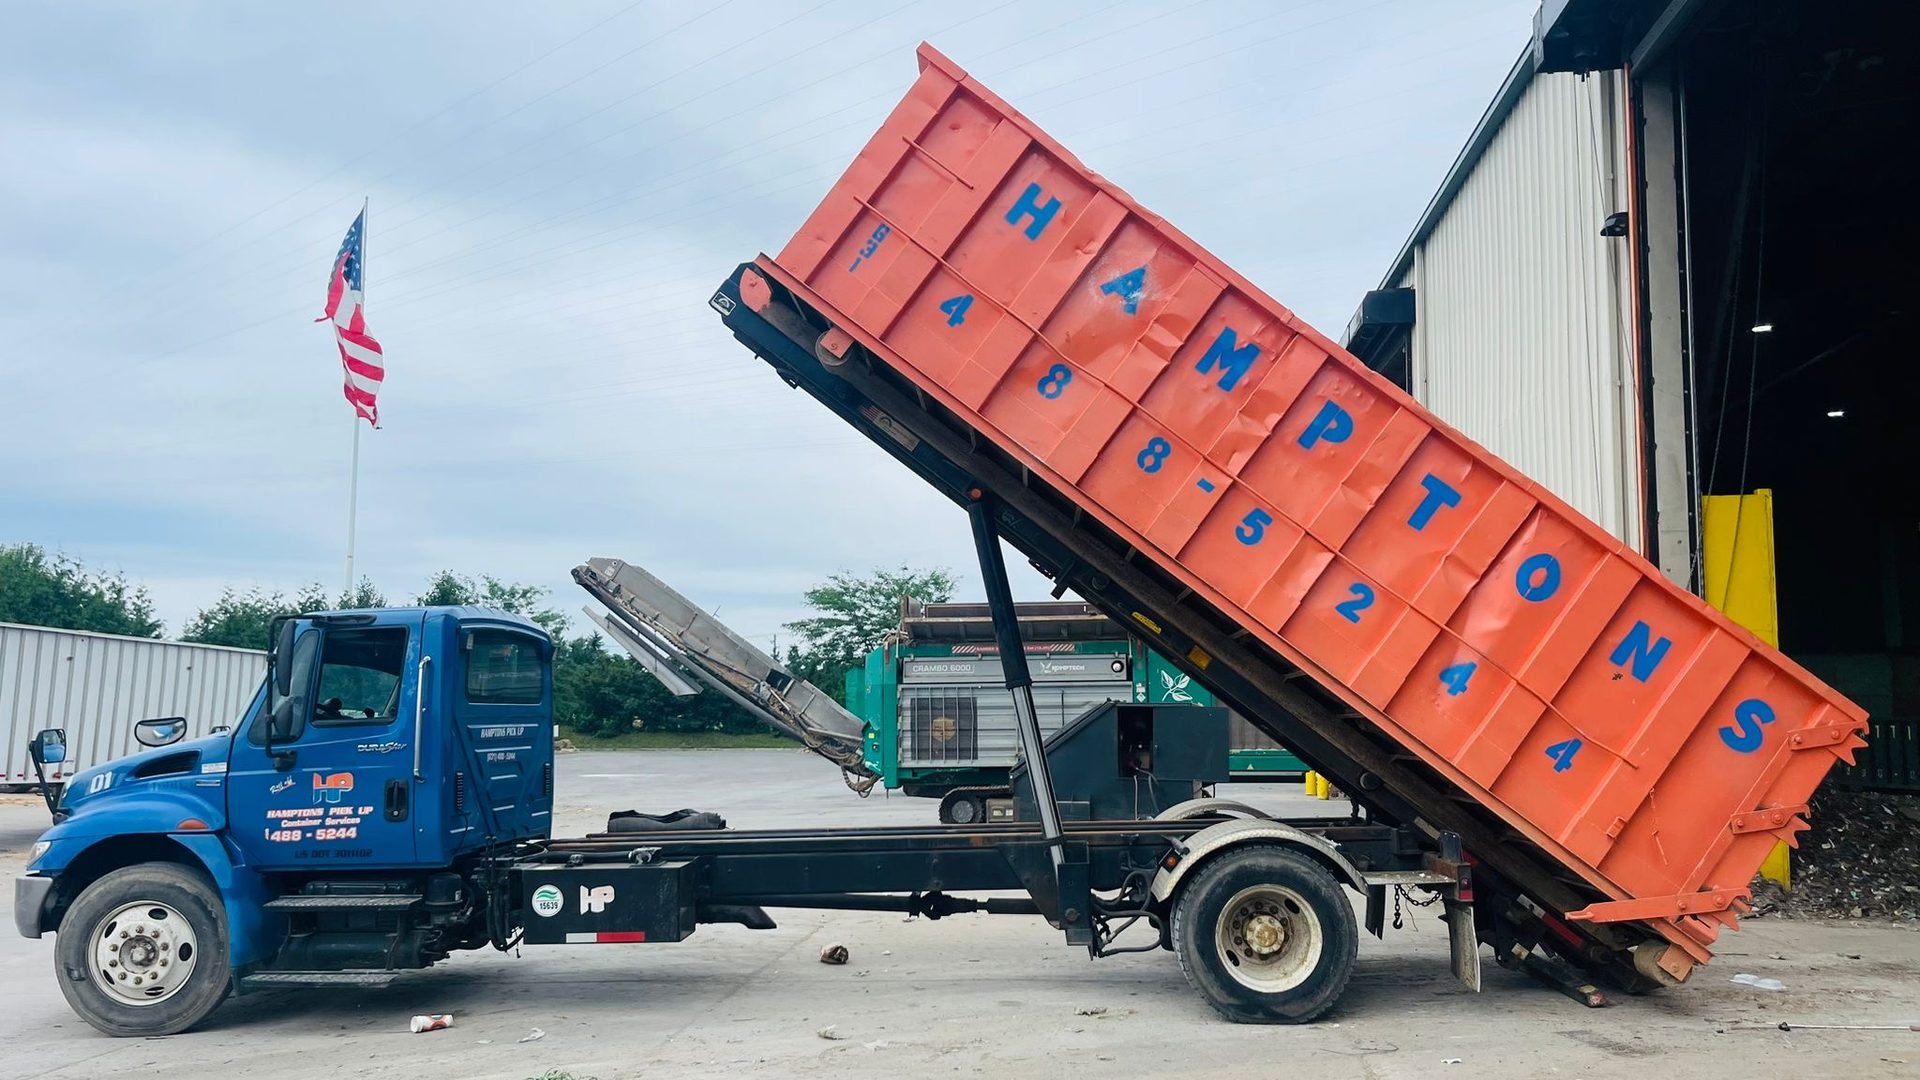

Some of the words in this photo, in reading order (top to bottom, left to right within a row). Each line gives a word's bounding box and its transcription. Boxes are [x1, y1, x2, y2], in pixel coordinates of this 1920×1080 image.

[912, 665, 948, 673] CRAMBO
[950, 664, 971, 672] 6000
[481, 728, 506, 738] HAMPTONS
[506, 727, 517, 736] PICK
[90, 771, 113, 793] 01
[312, 772, 354, 805] HP
[266, 807, 324, 819] HAMPTONS
[328, 806, 354, 816] PICK
[357, 806, 374, 815] UP
[281, 818, 322, 828] Container
[325, 816, 361, 826] Services
[270, 829, 302, 842] 488
[315, 826, 357, 840] 5244
[540, 901, 559, 910] 15639
[580, 884, 615, 915] HP
